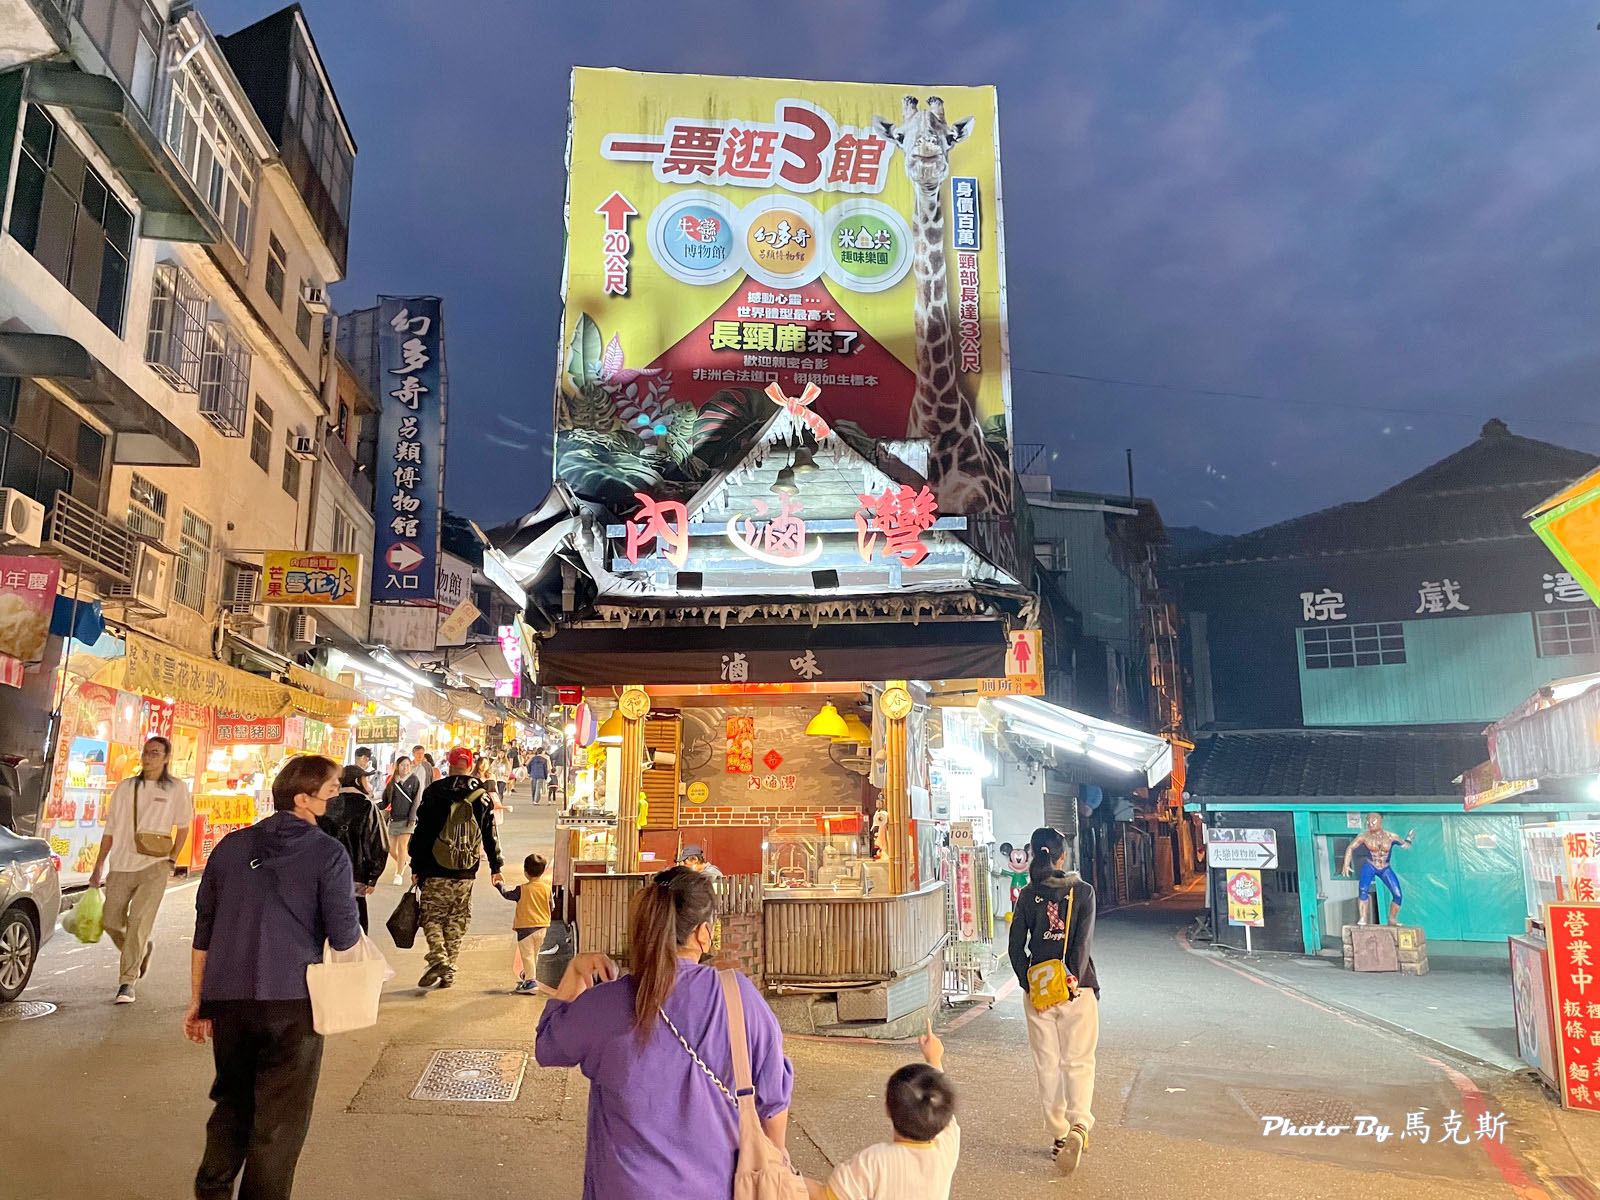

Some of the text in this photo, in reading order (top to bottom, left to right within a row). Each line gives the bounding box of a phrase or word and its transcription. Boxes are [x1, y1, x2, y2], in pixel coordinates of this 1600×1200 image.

[608, 105, 887, 186] 一票逛3館
[955, 181, 975, 247] 身價百萬
[675, 216, 718, 243] 失戀
[753, 220, 812, 249] 幻多奇
[604, 232, 630, 296] 20公尺
[684, 243, 726, 260] 博物館
[840, 250, 889, 265] 趣味樂園
[736, 306, 836, 322] 世界體型最高大
[958, 252, 979, 373] 頸部長達3公尺
[390, 308, 432, 410] 幻多奇
[743, 355, 829, 370] 歡迎親密合影
[390, 417, 422, 538] 另類博物館
[0, 568, 49, 591] 年慶
[266, 566, 285, 597] 芒果
[285, 566, 354, 600] 雪花冰
[385, 574, 419, 589] 入口
[720, 649, 824, 682] 滷味
[218, 724, 281, 739] 萬巒豬腳
[1213, 848, 1257, 861] 失戀博物館
[1563, 910, 1594, 996] 營業中
